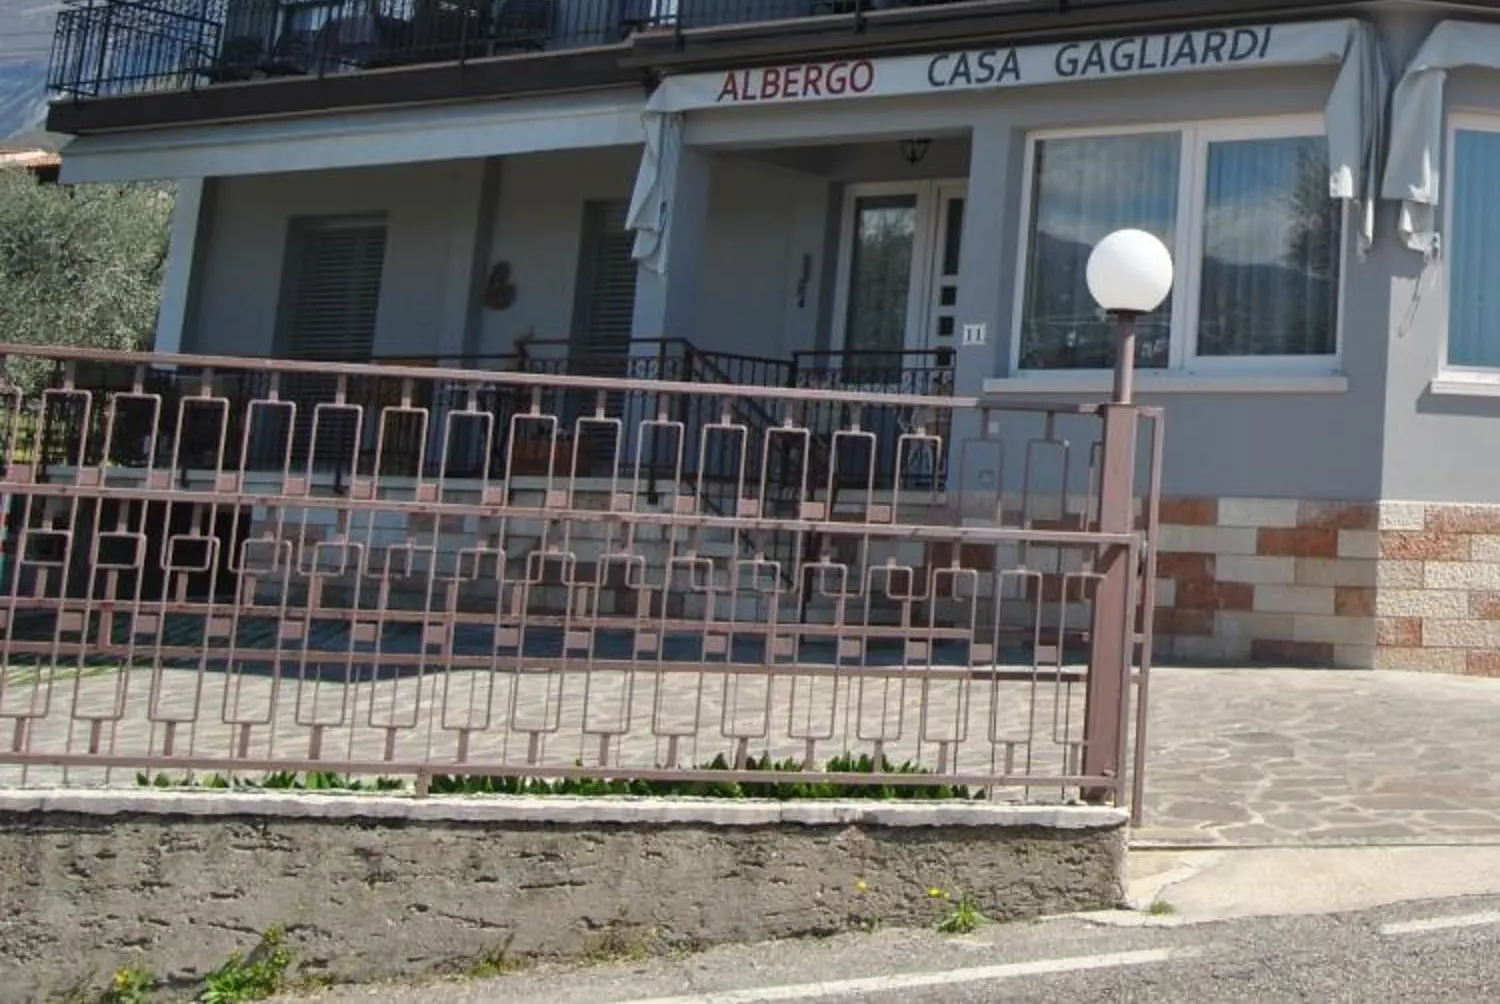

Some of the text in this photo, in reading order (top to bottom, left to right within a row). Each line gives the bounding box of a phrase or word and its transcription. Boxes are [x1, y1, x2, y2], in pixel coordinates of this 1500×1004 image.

[717, 27, 1272, 102] ALBERGO CASA GAGLIARDI
